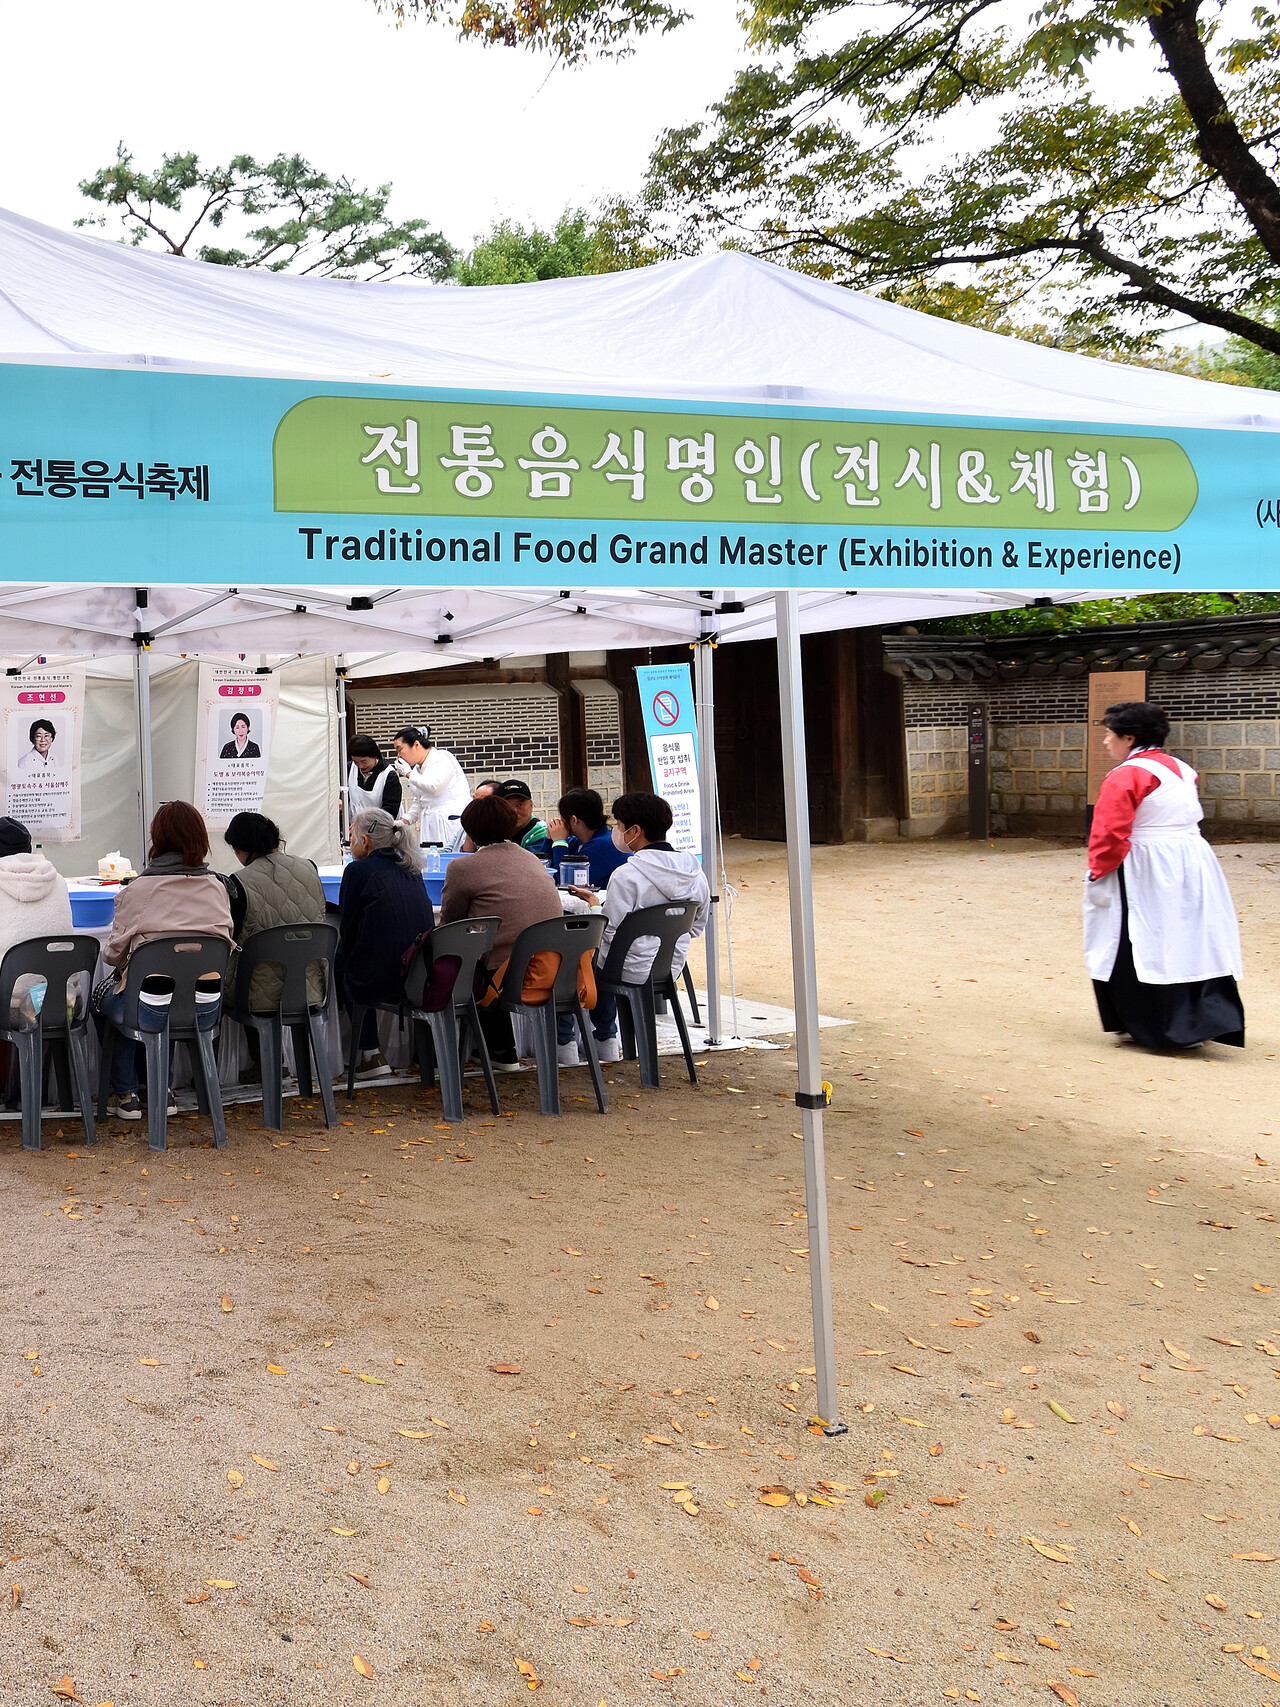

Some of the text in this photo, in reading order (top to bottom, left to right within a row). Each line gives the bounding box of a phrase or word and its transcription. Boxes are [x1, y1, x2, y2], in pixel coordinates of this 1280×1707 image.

[9, 457, 210, 502] 전통음식축제
[298, 527, 1182, 575] Traditional Food Grand Master (Exhibition & Experience)
